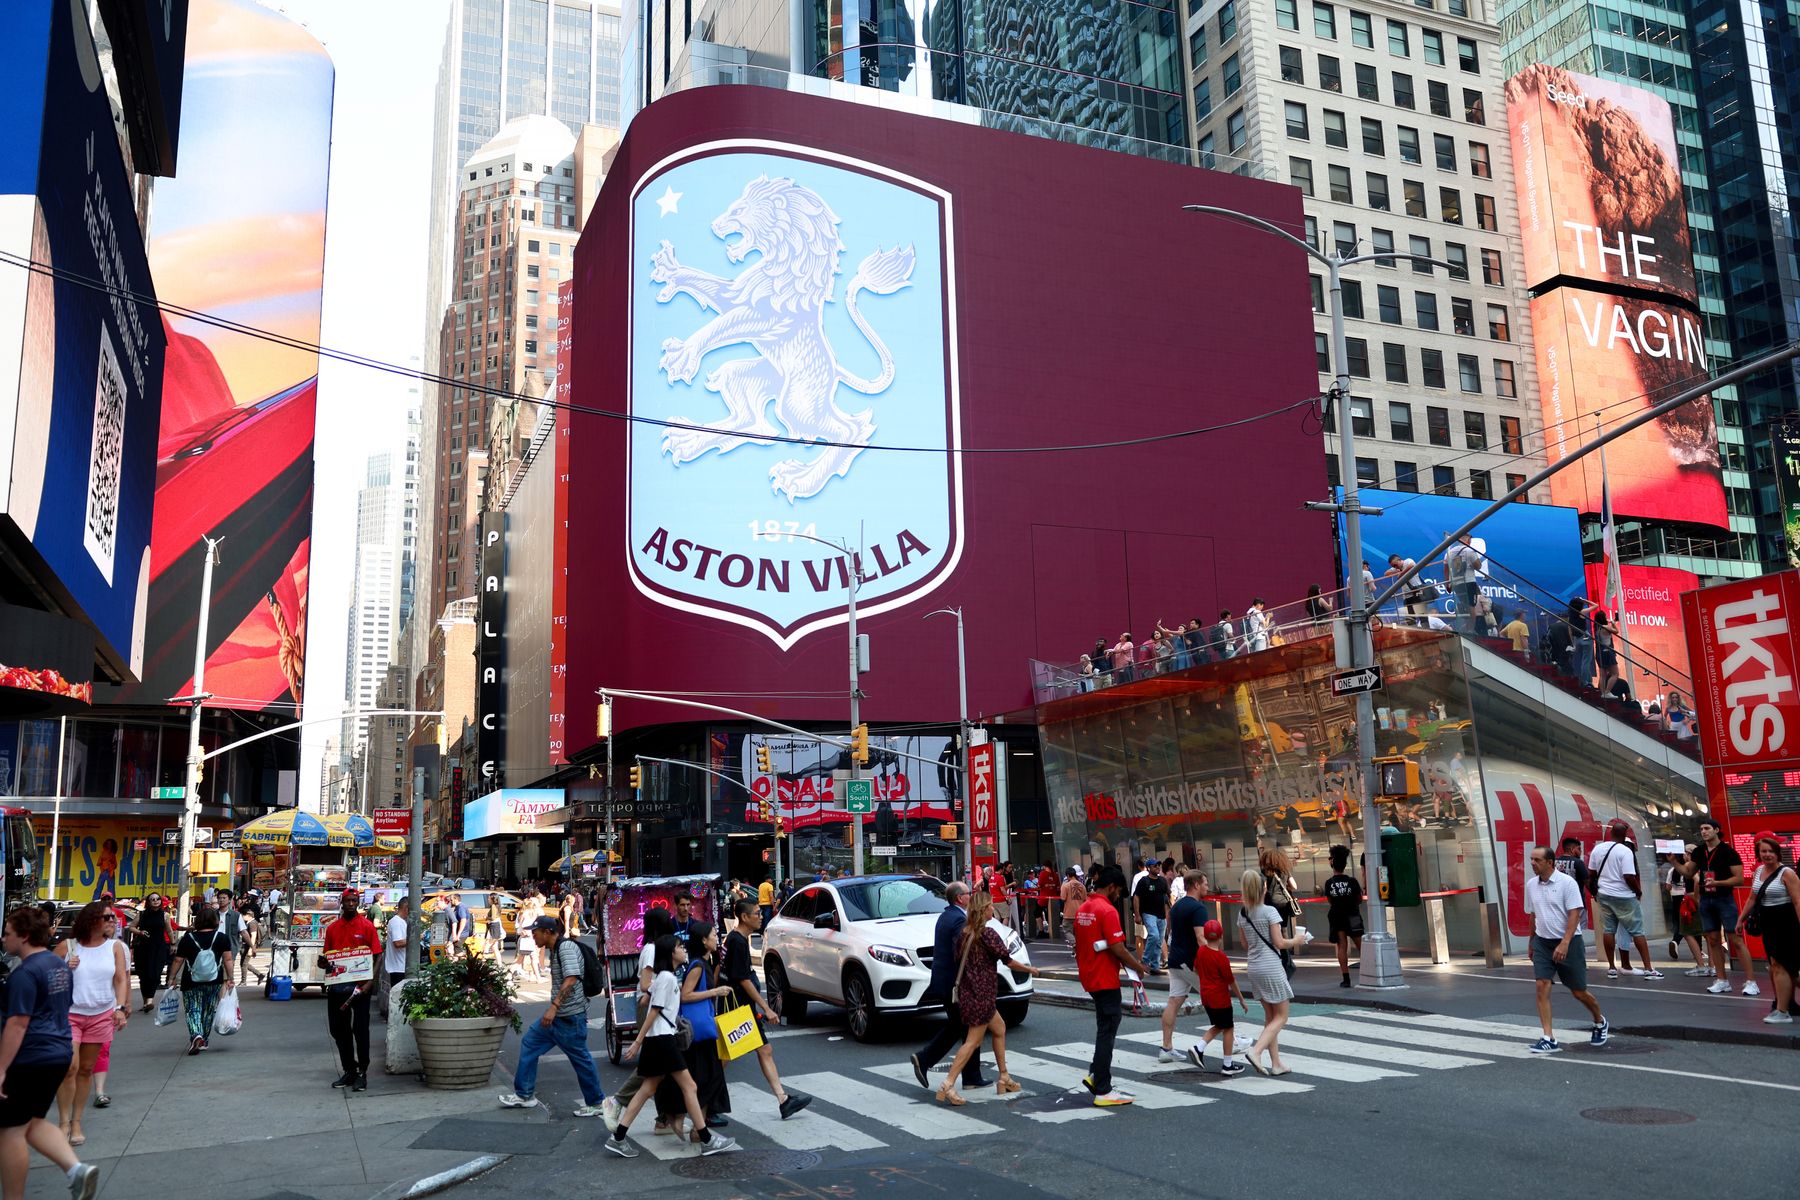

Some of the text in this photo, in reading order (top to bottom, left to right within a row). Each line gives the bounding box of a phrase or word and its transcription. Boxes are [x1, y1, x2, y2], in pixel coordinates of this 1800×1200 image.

[1547, 84, 1586, 108] Seed
[83, 186, 100, 262] FREE
[1562, 220, 1661, 283] THE
[1572, 297, 1709, 372] VAGIN
[748, 519, 817, 544] 1874
[642, 526, 932, 593] ASTON VILLA
[1640, 613, 1668, 627] now.
[1702, 614, 1712, 644] service
[482, 530, 500, 777] PALACE
[1708, 654, 1718, 684] theatre
[1713, 588, 1793, 756] tkts
[1338, 674, 1373, 689] ONE WAY
[1712, 685, 1726, 738] development
[1719, 738, 1729, 757] fund
[974, 750, 991, 829] tkts
[243, 832, 289, 842] SABRETT
